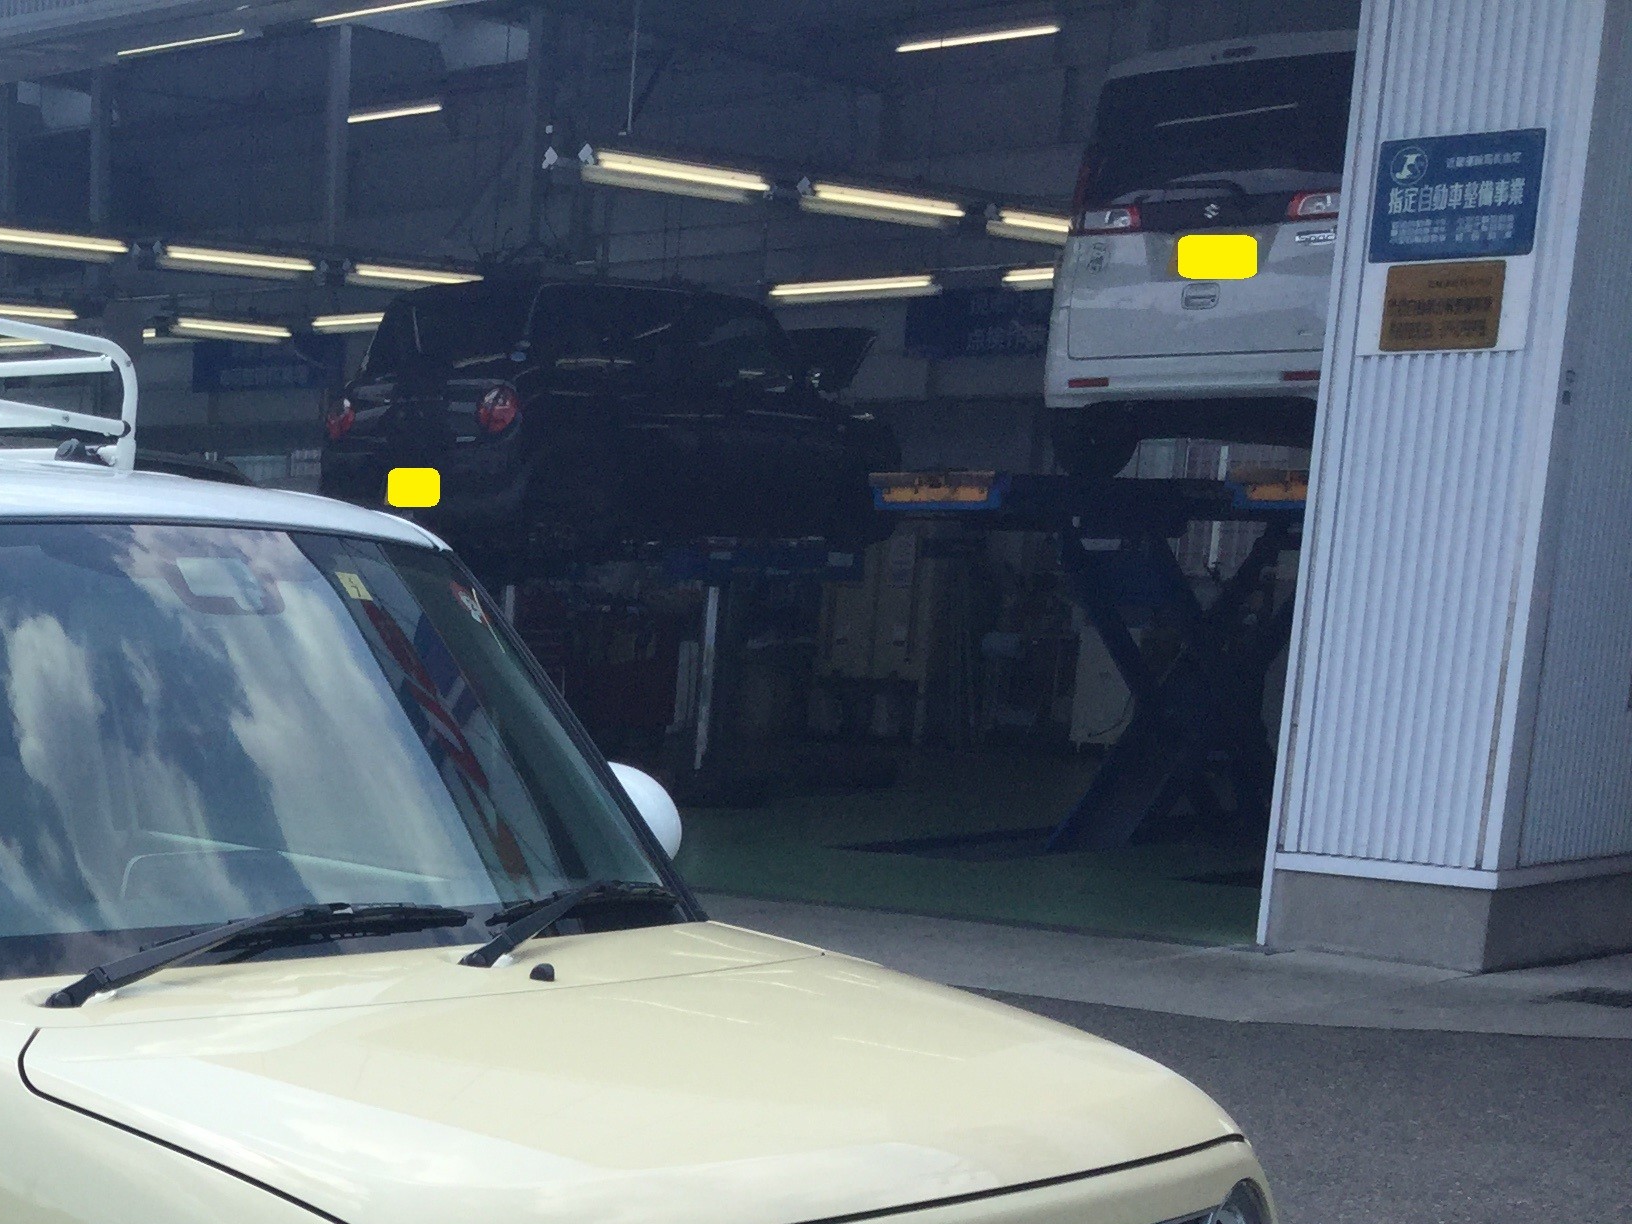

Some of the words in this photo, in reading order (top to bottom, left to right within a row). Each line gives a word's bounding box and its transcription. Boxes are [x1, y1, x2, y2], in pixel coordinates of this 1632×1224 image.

[1388, 178, 1525, 215] 指定自動車整備事業
